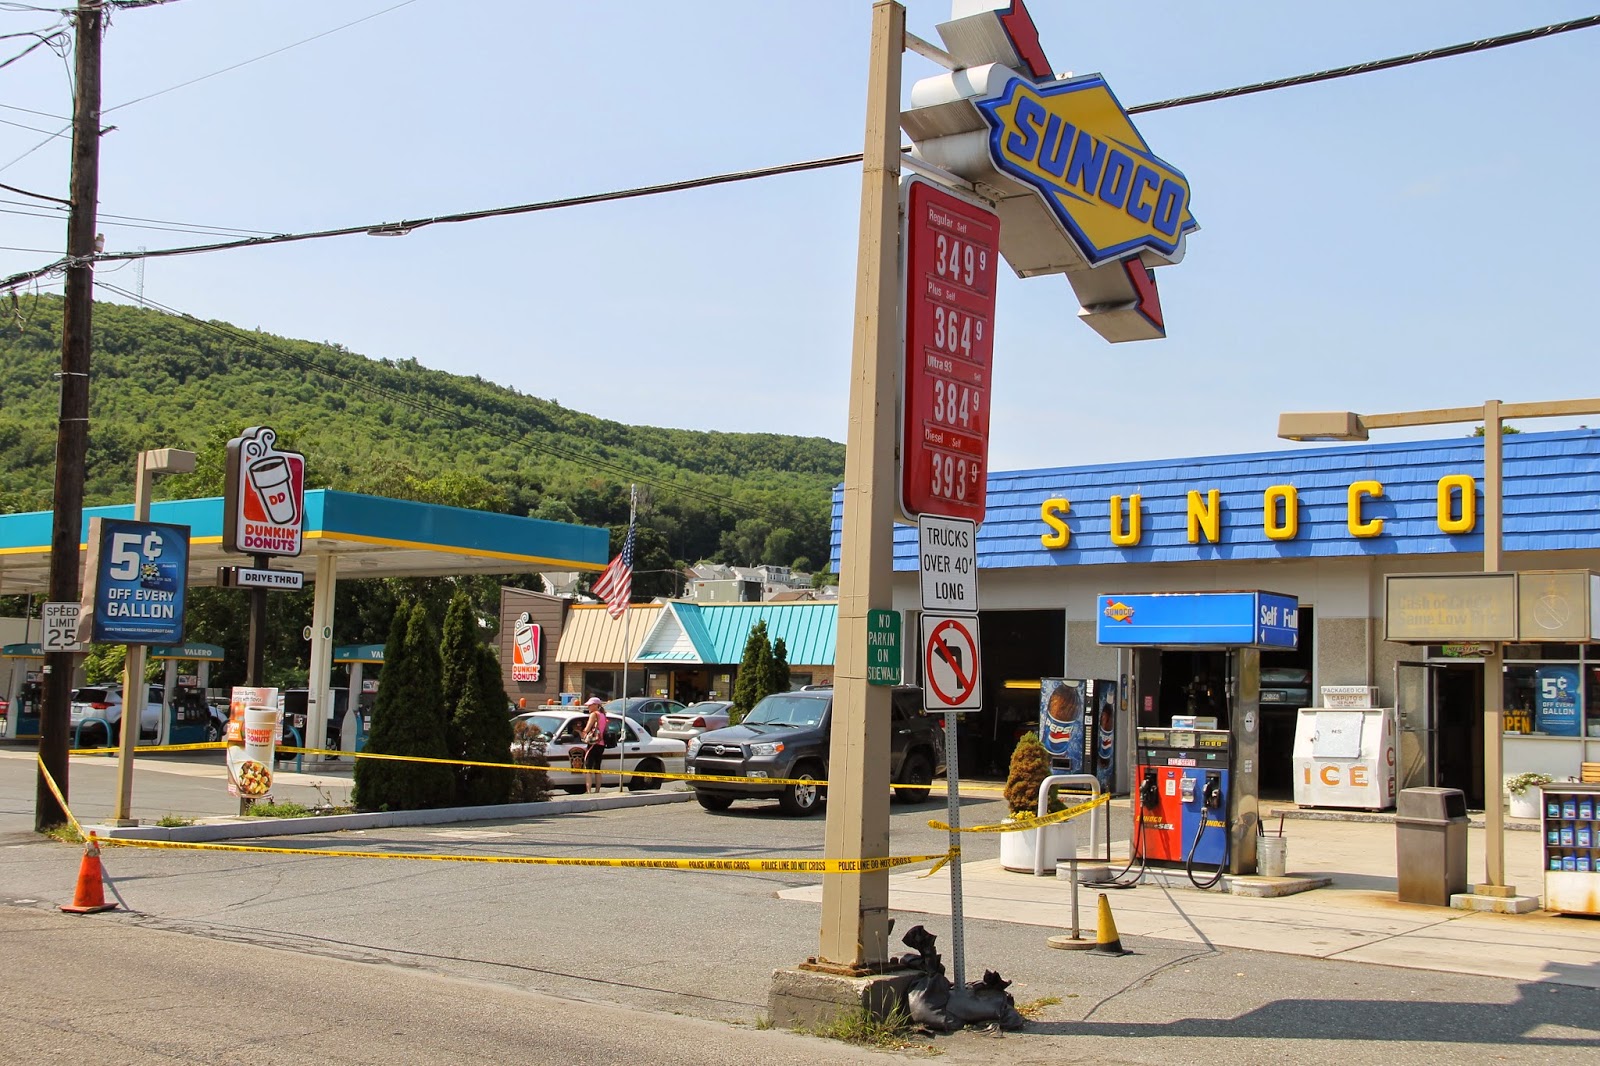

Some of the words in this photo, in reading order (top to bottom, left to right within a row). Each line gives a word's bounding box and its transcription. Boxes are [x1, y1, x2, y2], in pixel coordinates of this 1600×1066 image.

[1006, 96, 1186, 237] SUNOCO
[928, 208, 953, 228] Regular
[956, 222, 967, 234] Self
[928, 282, 942, 296] Plus
[946, 290, 956, 300] Self
[924, 428, 944, 443] Diesel
[952, 438, 962, 448] Self
[268, 492, 286, 506] DD
[1040, 474, 1476, 550] SUNOCO
[245, 524, 298, 540] DUNKIN'
[926, 527, 969, 548] TRUCKS
[244, 536, 296, 551] DONUTS
[110, 531, 163, 580] 5¢
[924, 554, 950, 573] OVER
[954, 557, 973, 574] 40'
[245, 573, 273, 583] DRIVE
[275, 574, 298, 585] THRU
[108, 588, 132, 600] OFF
[136, 590, 174, 602] EVERY
[935, 582, 964, 600] LONG
[46, 607, 79, 616] SPEED
[107, 602, 174, 618] GALLON
[1261, 605, 1277, 626] Self
[1283, 608, 1298, 628] Full
[50, 619, 76, 627] LIMIT
[879, 614, 890, 628] NO
[48, 629, 76, 646] 25
[869, 632, 895, 646] PARKIN
[878, 649, 888, 662] ON
[868, 666, 900, 680] SIDEWALK
[1046, 718, 1074, 734] PEPSI
[1504, 716, 1531, 733] PEN
[1304, 764, 1368, 786] ICE
[716, 861, 722, 869] DO
[724, 861, 733, 869] NOT
[734, 861, 750, 870] CROSS
[762, 862, 778, 870] POLICE
[779, 862, 789, 870] LINE
[790, 862, 797, 870] DO
[798, 862, 807, 870] NOT
[809, 862, 826, 870] CROSS
[838, 862, 855, 870] POLICE
[857, 861, 869, 870] LINE
[880, 859, 890, 868] NOT
[892, 857, 911, 866] CROSS
